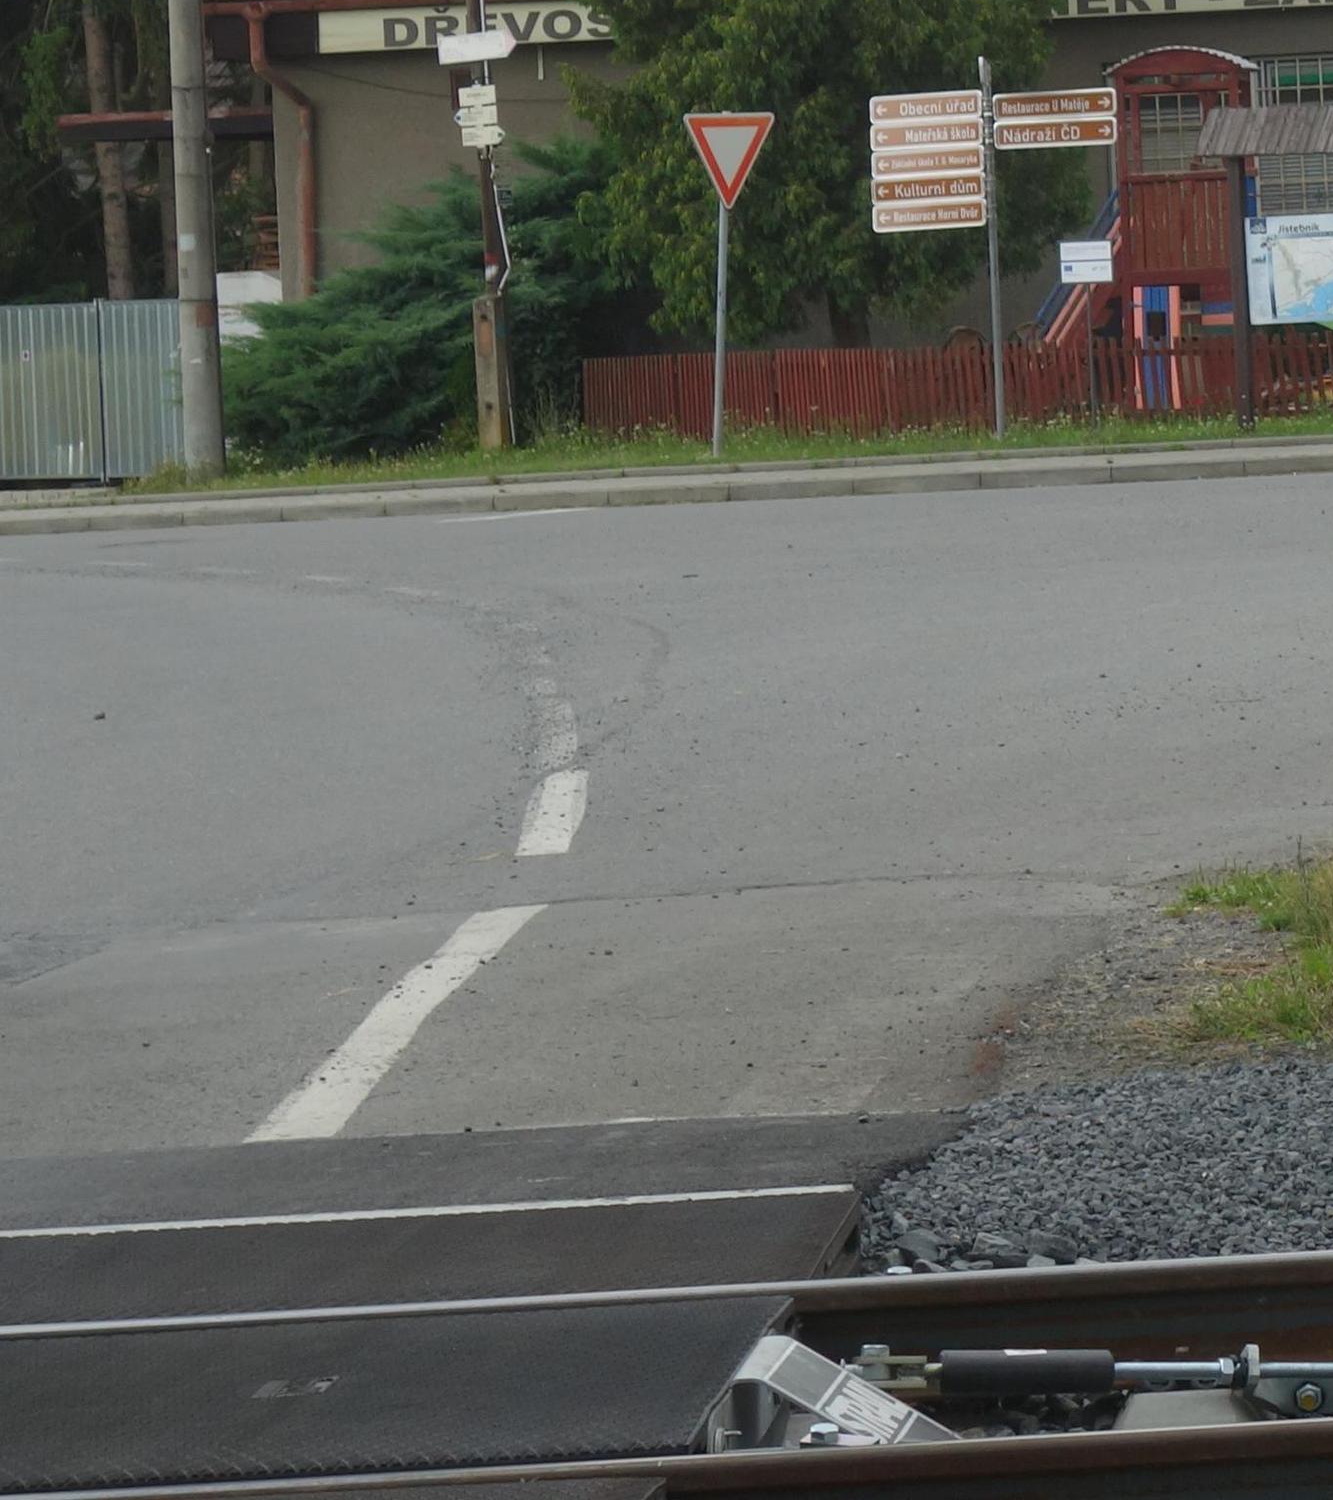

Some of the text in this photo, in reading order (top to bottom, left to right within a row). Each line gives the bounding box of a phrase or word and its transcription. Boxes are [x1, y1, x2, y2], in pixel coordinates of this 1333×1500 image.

[899, 98, 976, 116] Obecní úřad
[1001, 102, 1050, 115] Restaurace
[1051, 100, 1058, 111] U
[905, 126, 976, 142] Mateřská škola
[1002, 123, 1080, 143] Nádraží ČD
[894, 179, 978, 198] Kulturní dům
